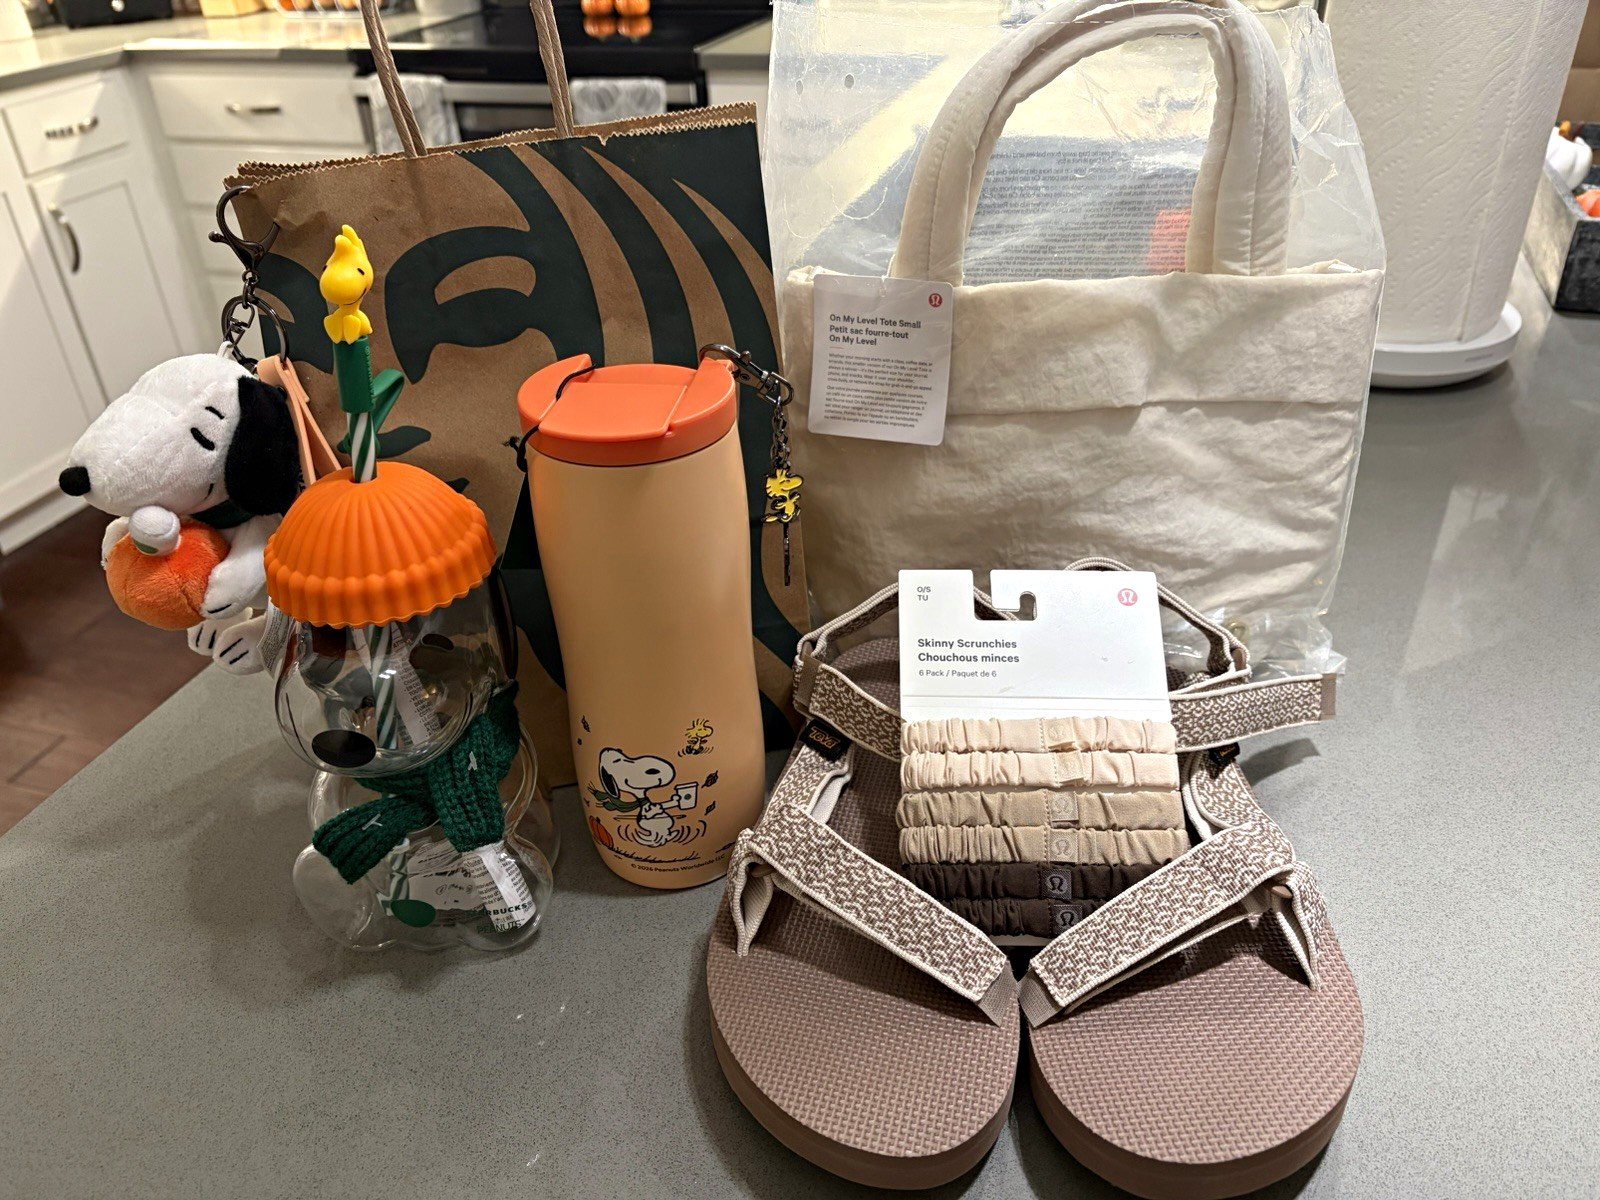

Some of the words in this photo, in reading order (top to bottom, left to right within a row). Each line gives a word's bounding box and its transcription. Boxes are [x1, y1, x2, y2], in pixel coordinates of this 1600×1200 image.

[843, 315, 854, 323] My
[857, 317, 877, 325] Level
[880, 318, 897, 326] Tote
[899, 320, 921, 328] Small
[830, 325, 847, 333] Petit
[865, 328, 908, 339] fourre-tout
[842, 336, 854, 344] My
[857, 337, 876, 345] Level
[918, 639, 954, 649] Skinny
[957, 639, 1017, 648] Scrunchies
[918, 653, 978, 662] Chouchous
[981, 654, 1020, 663] minces
[952, 670, 978, 678] Paquet
[681, 860, 714, 871] Worldwide
[716, 854, 724, 862] LLC
[470, 903, 527, 916] RBUCKS
